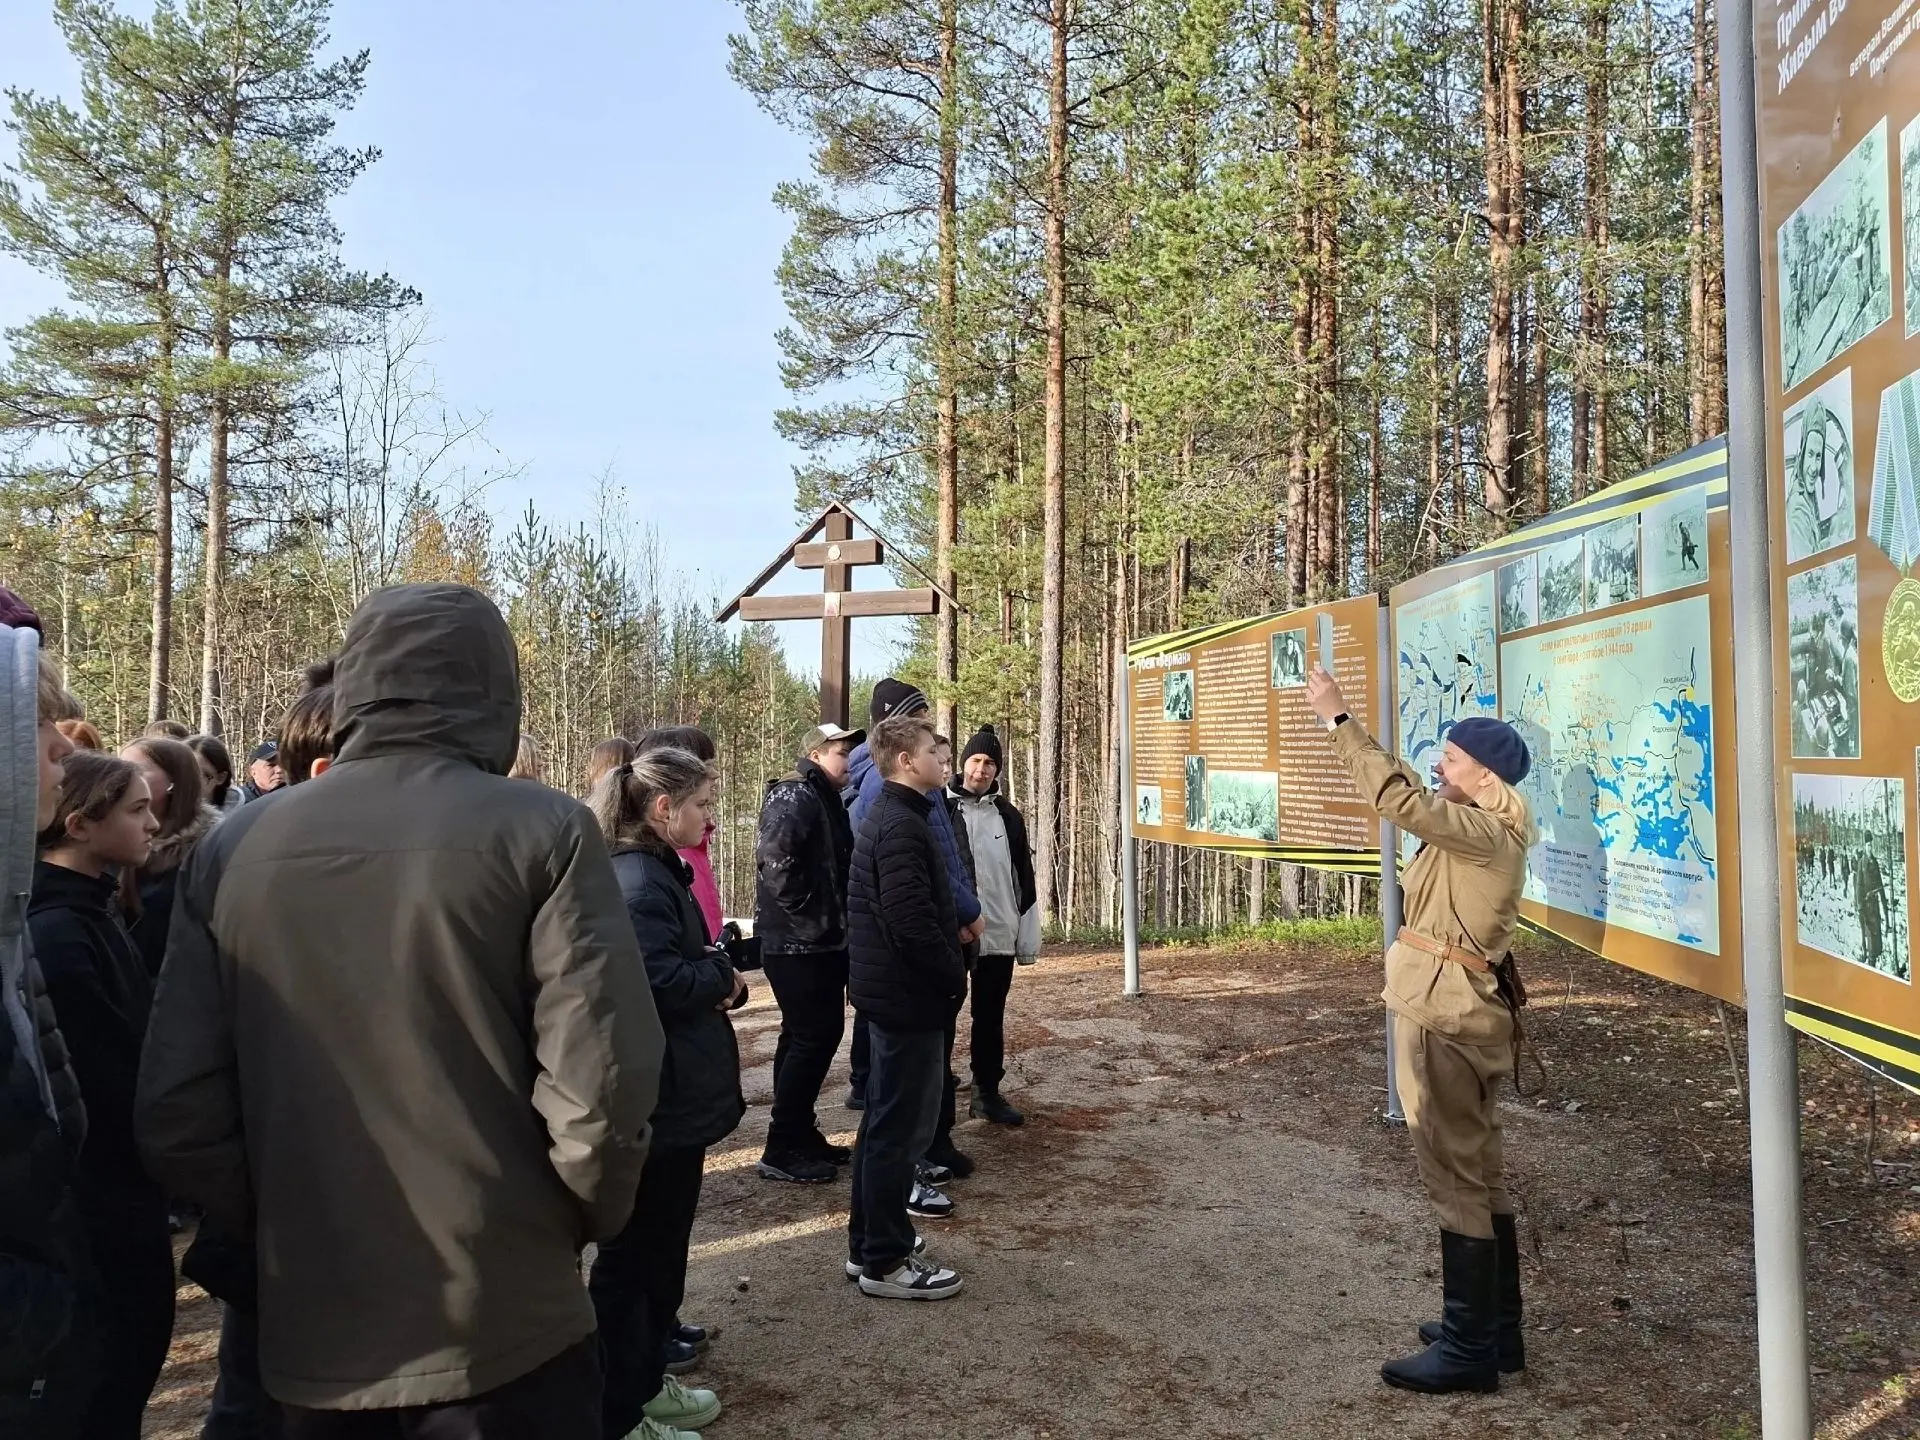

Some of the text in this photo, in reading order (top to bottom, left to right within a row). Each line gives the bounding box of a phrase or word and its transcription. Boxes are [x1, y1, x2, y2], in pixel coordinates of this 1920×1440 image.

[1777, 0, 1814, 50] Прим
[1777, 10, 1827, 95] Живым
[1870, 16, 1911, 79] Почетный
[1849, 30, 1881, 77] ветеран
